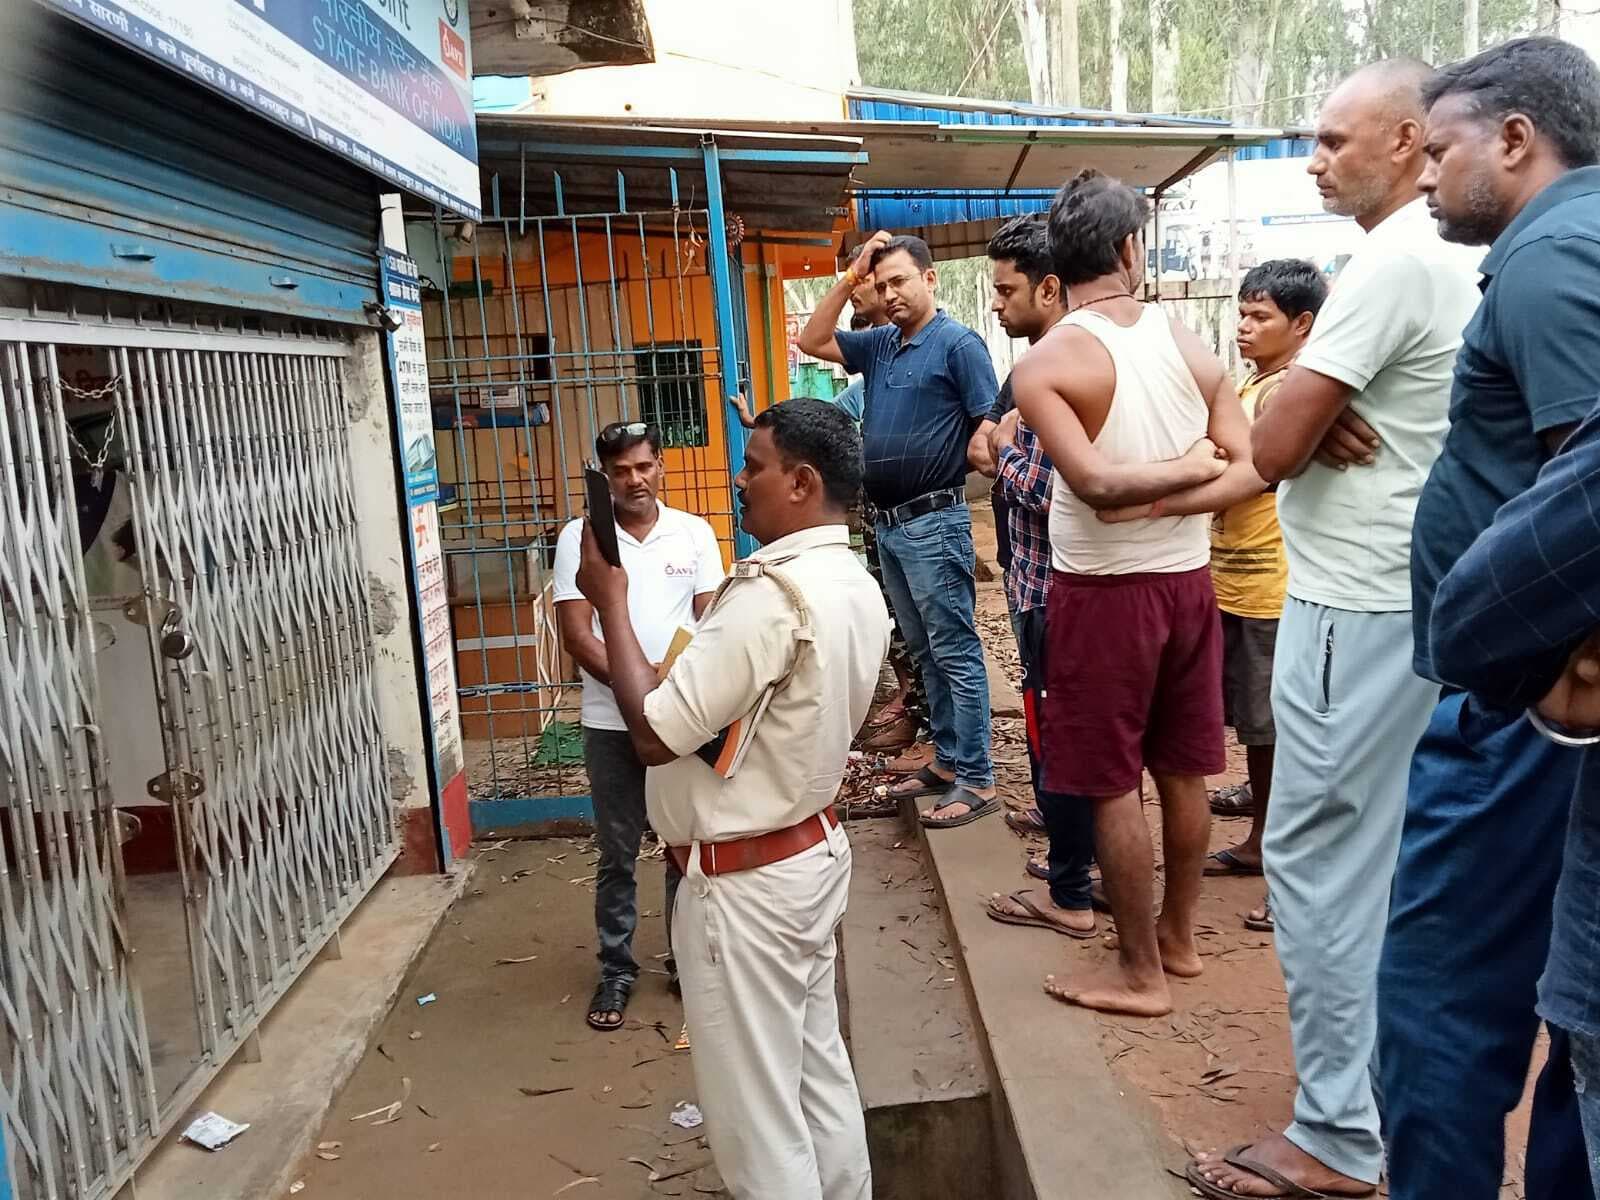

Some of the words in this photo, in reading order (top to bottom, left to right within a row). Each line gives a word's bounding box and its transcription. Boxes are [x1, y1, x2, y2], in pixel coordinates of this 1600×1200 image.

[312, 15, 368, 81] STATE
[370, 59, 410, 112] BANK
[412, 92, 430, 122] OF
[432, 104, 464, 149] INDIA
